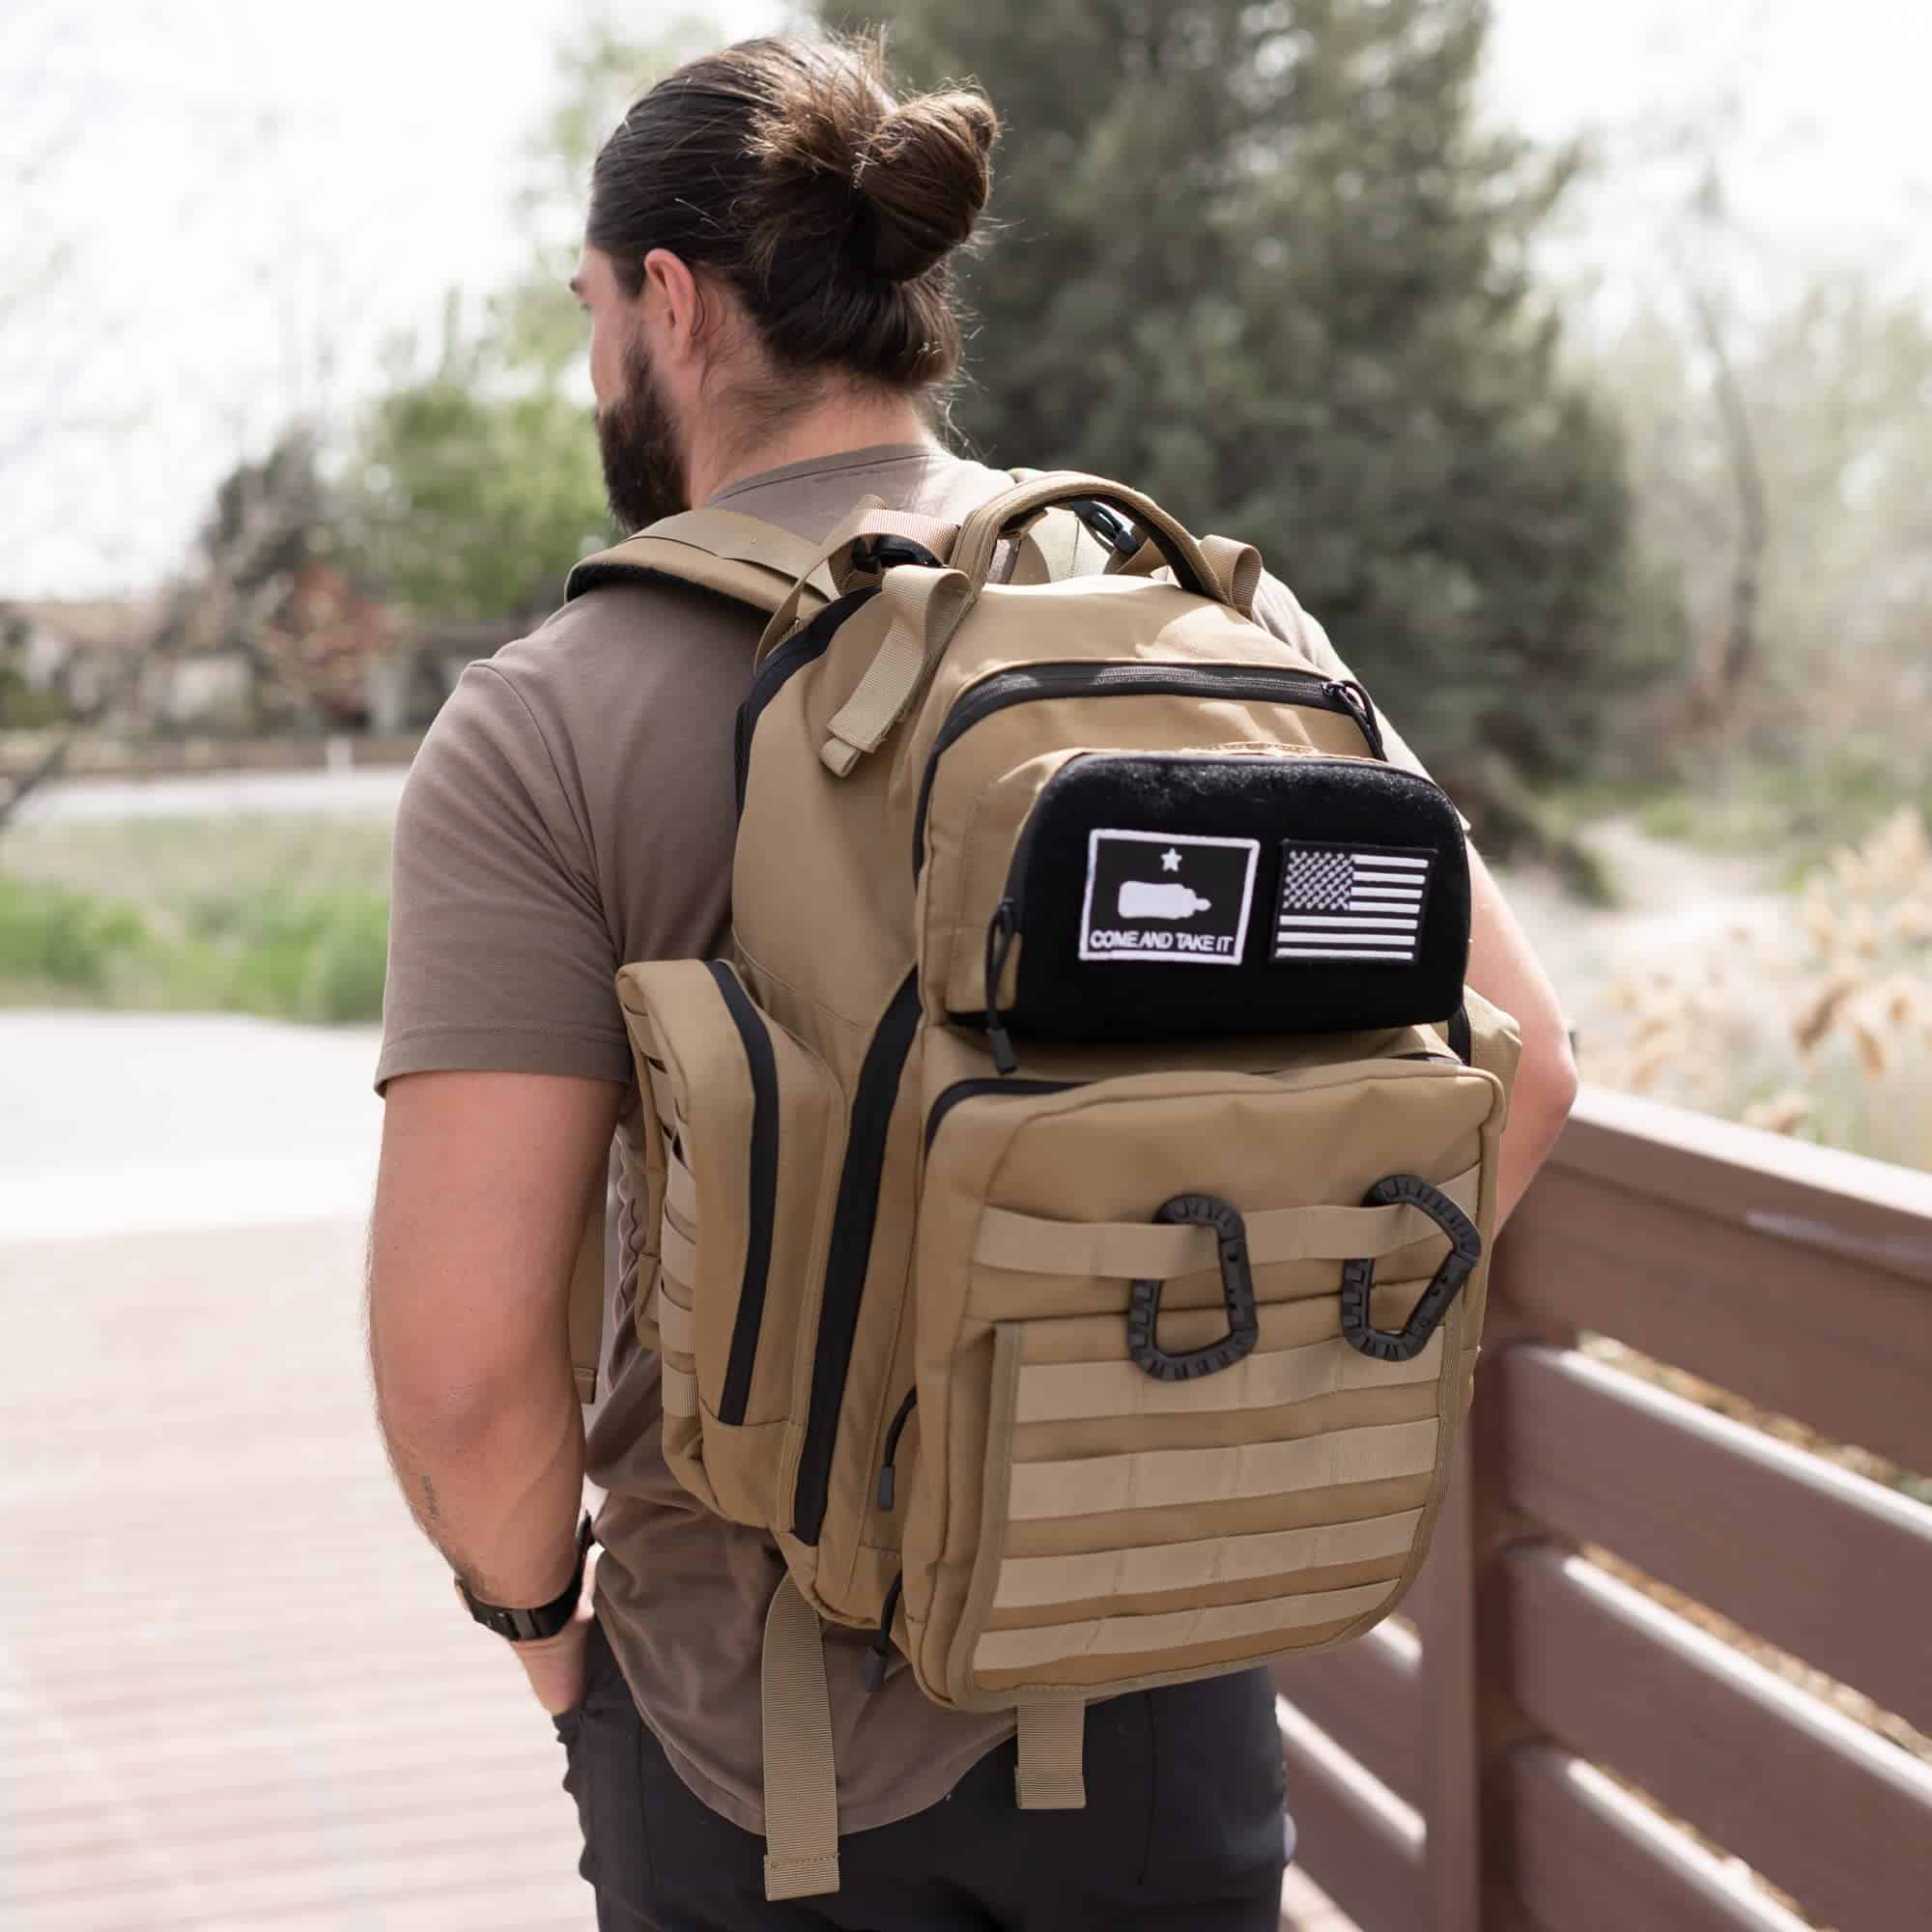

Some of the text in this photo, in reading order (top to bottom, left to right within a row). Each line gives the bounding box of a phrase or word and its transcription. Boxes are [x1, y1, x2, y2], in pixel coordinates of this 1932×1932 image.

[1090, 929, 1234, 952] COME AND TAKE IT
